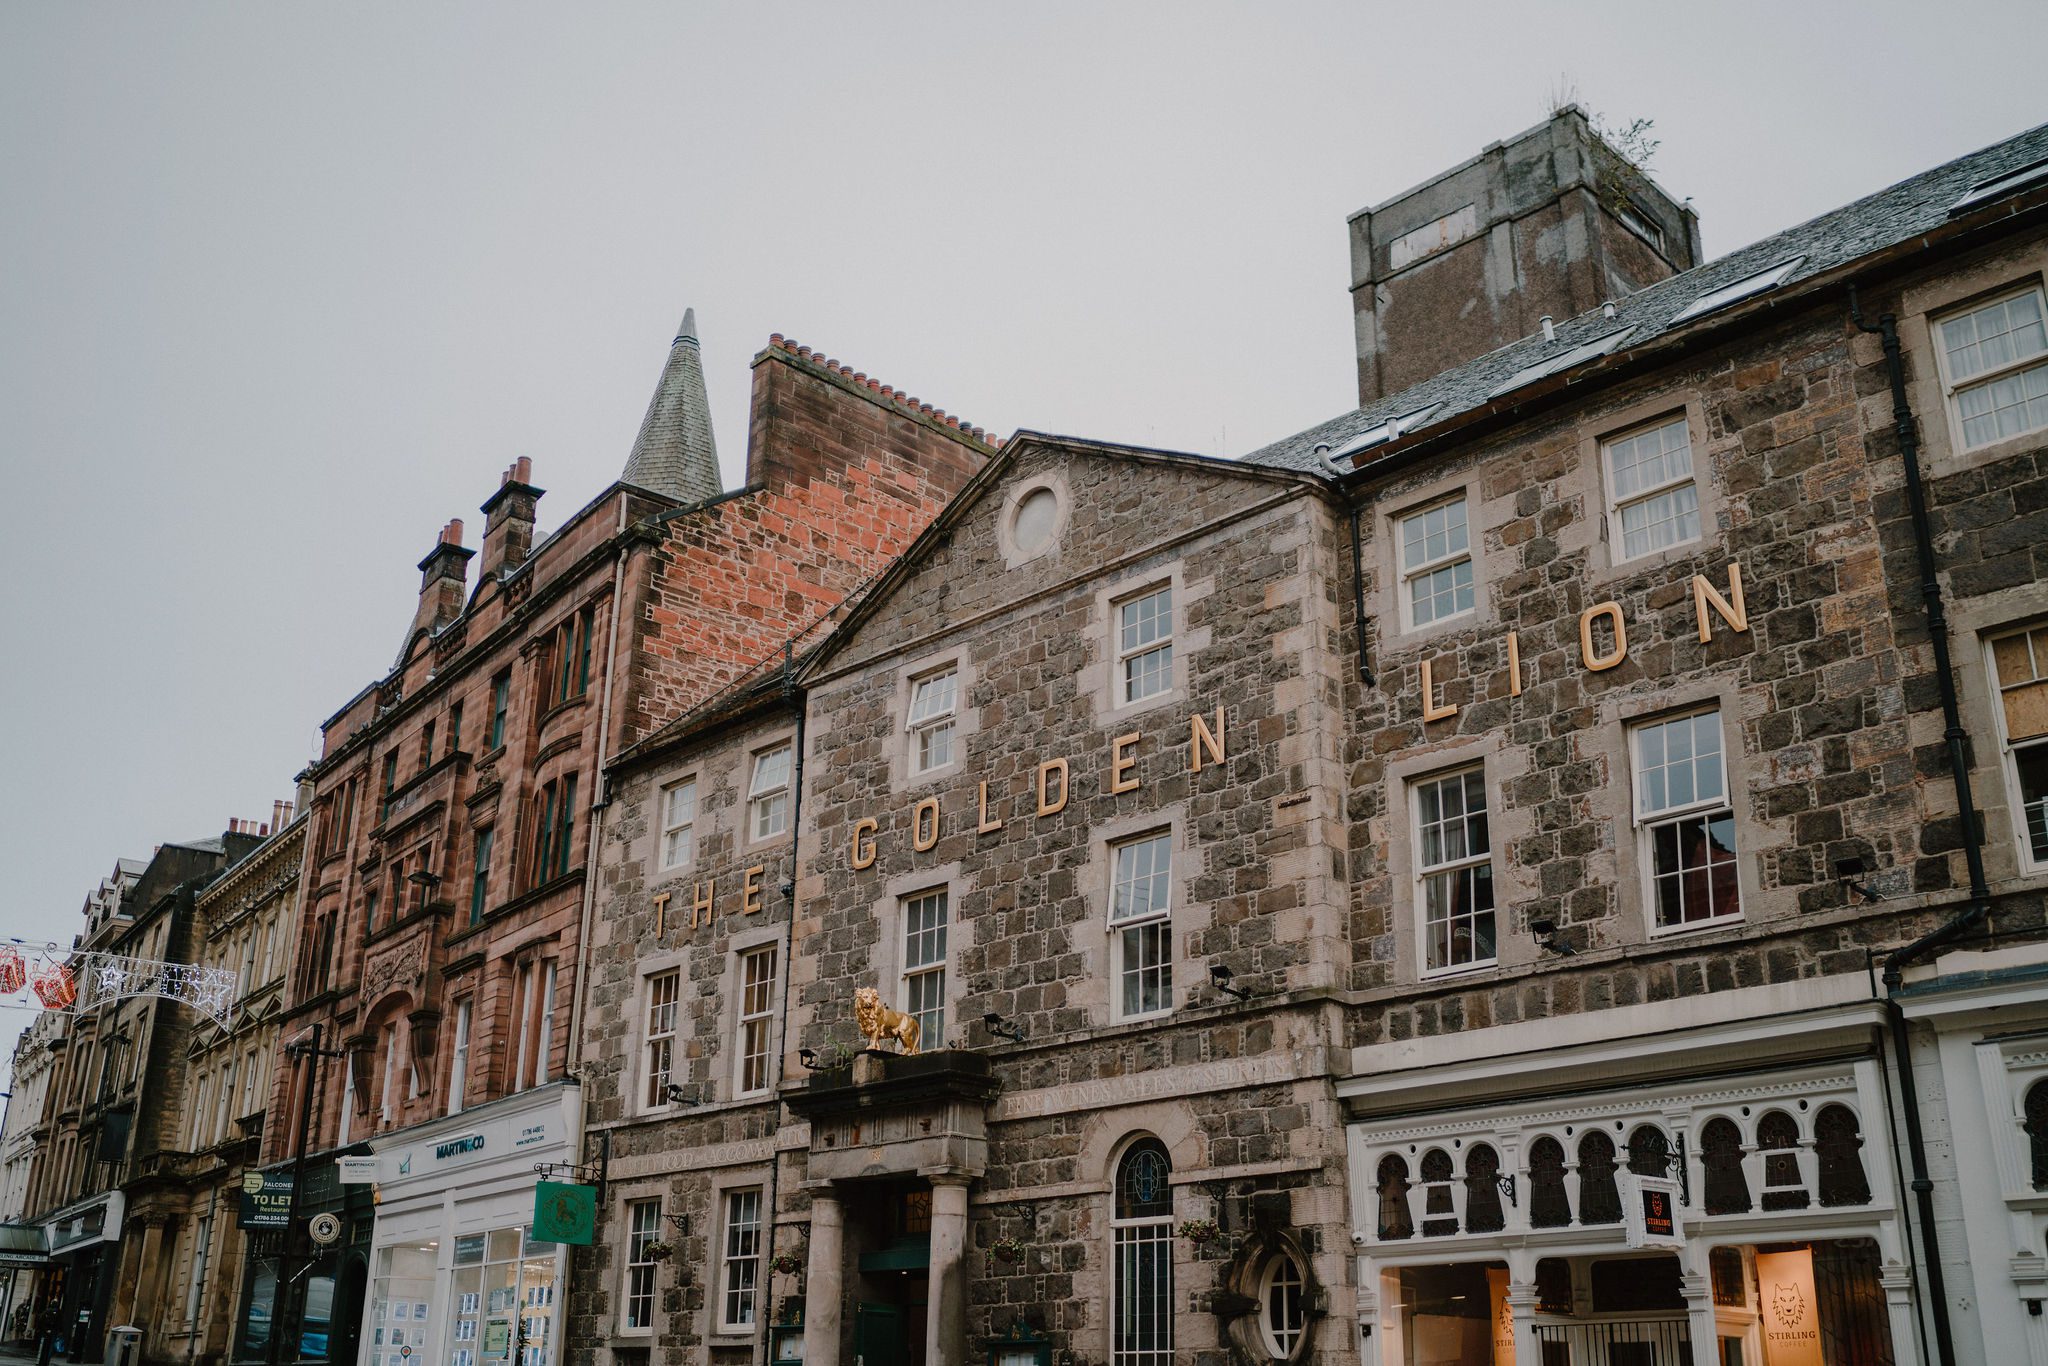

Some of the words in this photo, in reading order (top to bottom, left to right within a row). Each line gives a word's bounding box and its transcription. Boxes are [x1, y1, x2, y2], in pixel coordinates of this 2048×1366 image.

[653, 864, 764, 940] THE
[851, 706, 1225, 870] GOLDEN
[1422, 562, 1748, 723] LION
[1004, 1093, 1044, 1116] FINE
[436, 1135, 486, 1160] MARTIN&CO
[252, 1195, 269, 1205] TO
[270, 1195, 293, 1206] LET
[1647, 1217, 1671, 1227] STIRLING
[1768, 1330, 1816, 1340] STIRLING
[1779, 1341, 1808, 1349] COFFEE
